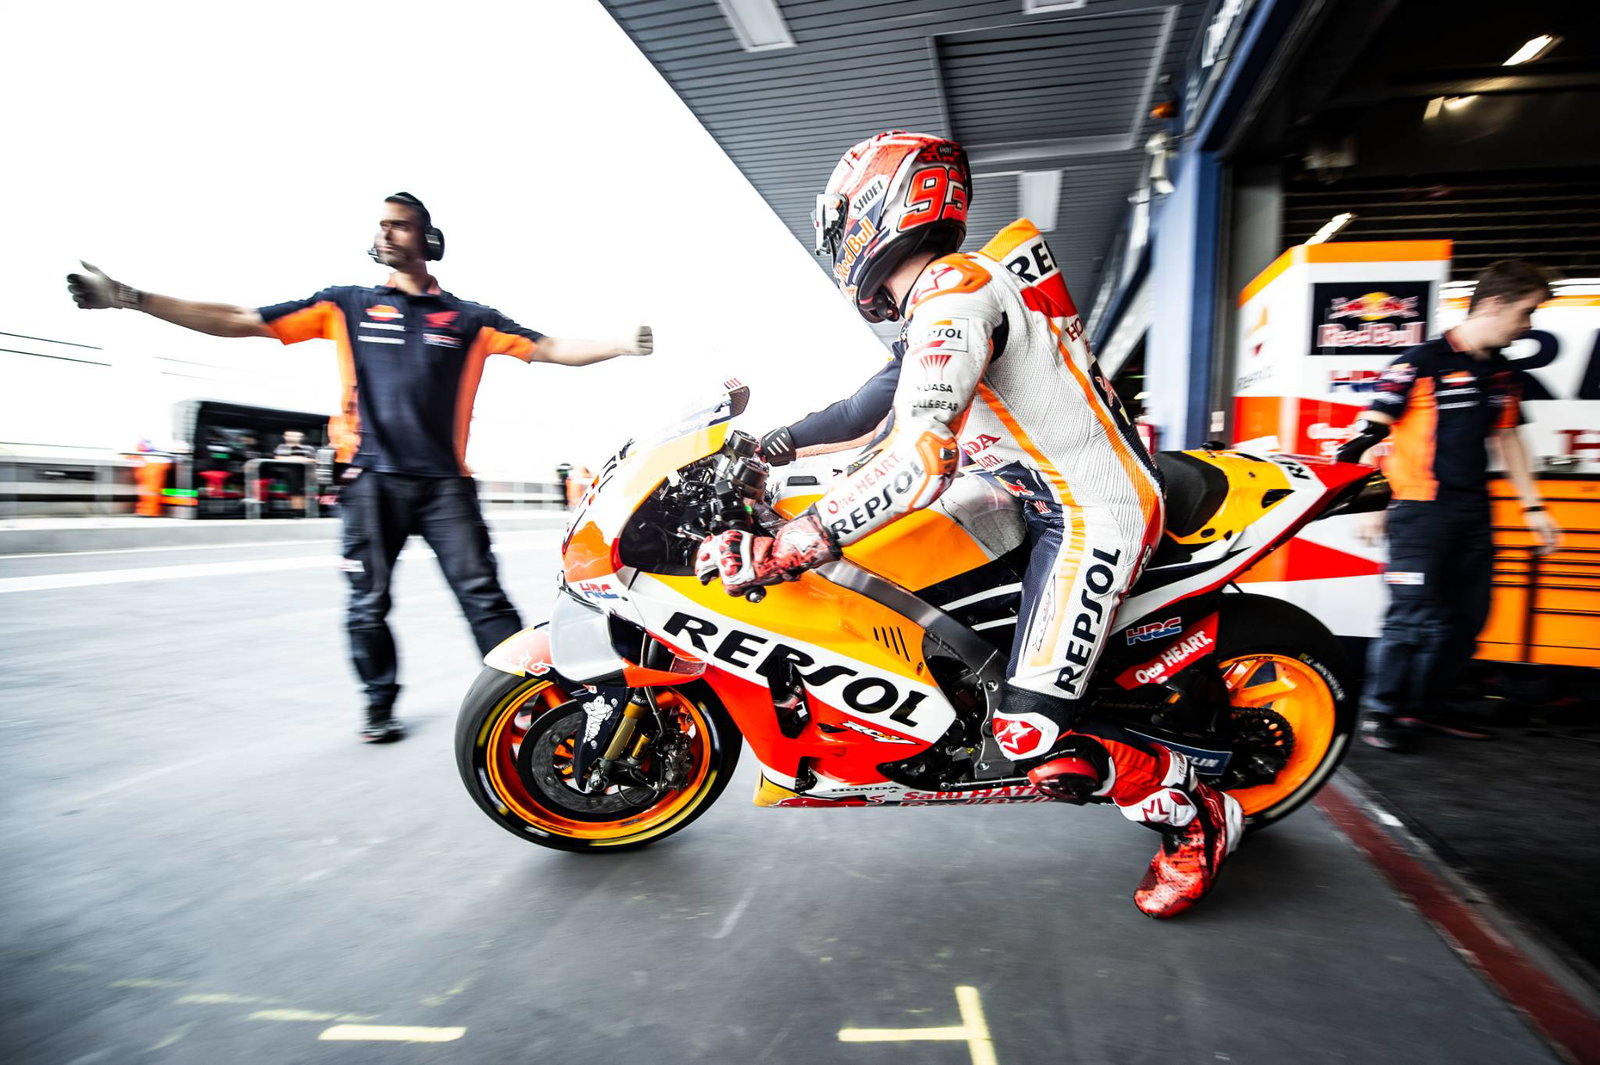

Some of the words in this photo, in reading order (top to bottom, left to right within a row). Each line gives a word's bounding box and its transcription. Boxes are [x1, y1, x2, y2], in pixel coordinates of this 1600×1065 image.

[853, 180, 884, 213] SHOEI
[848, 217, 879, 257] Bull
[1006, 240, 1058, 283] RE
[830, 460, 925, 540] REPSOL
[1053, 548, 1121, 695] REPSOL
[1126, 616, 1183, 646] HRC
[663, 611, 930, 728] REPSOL
[1135, 662, 1166, 684] One
[831, 785, 900, 793] HONDA
[902, 791, 964, 801] Satu
